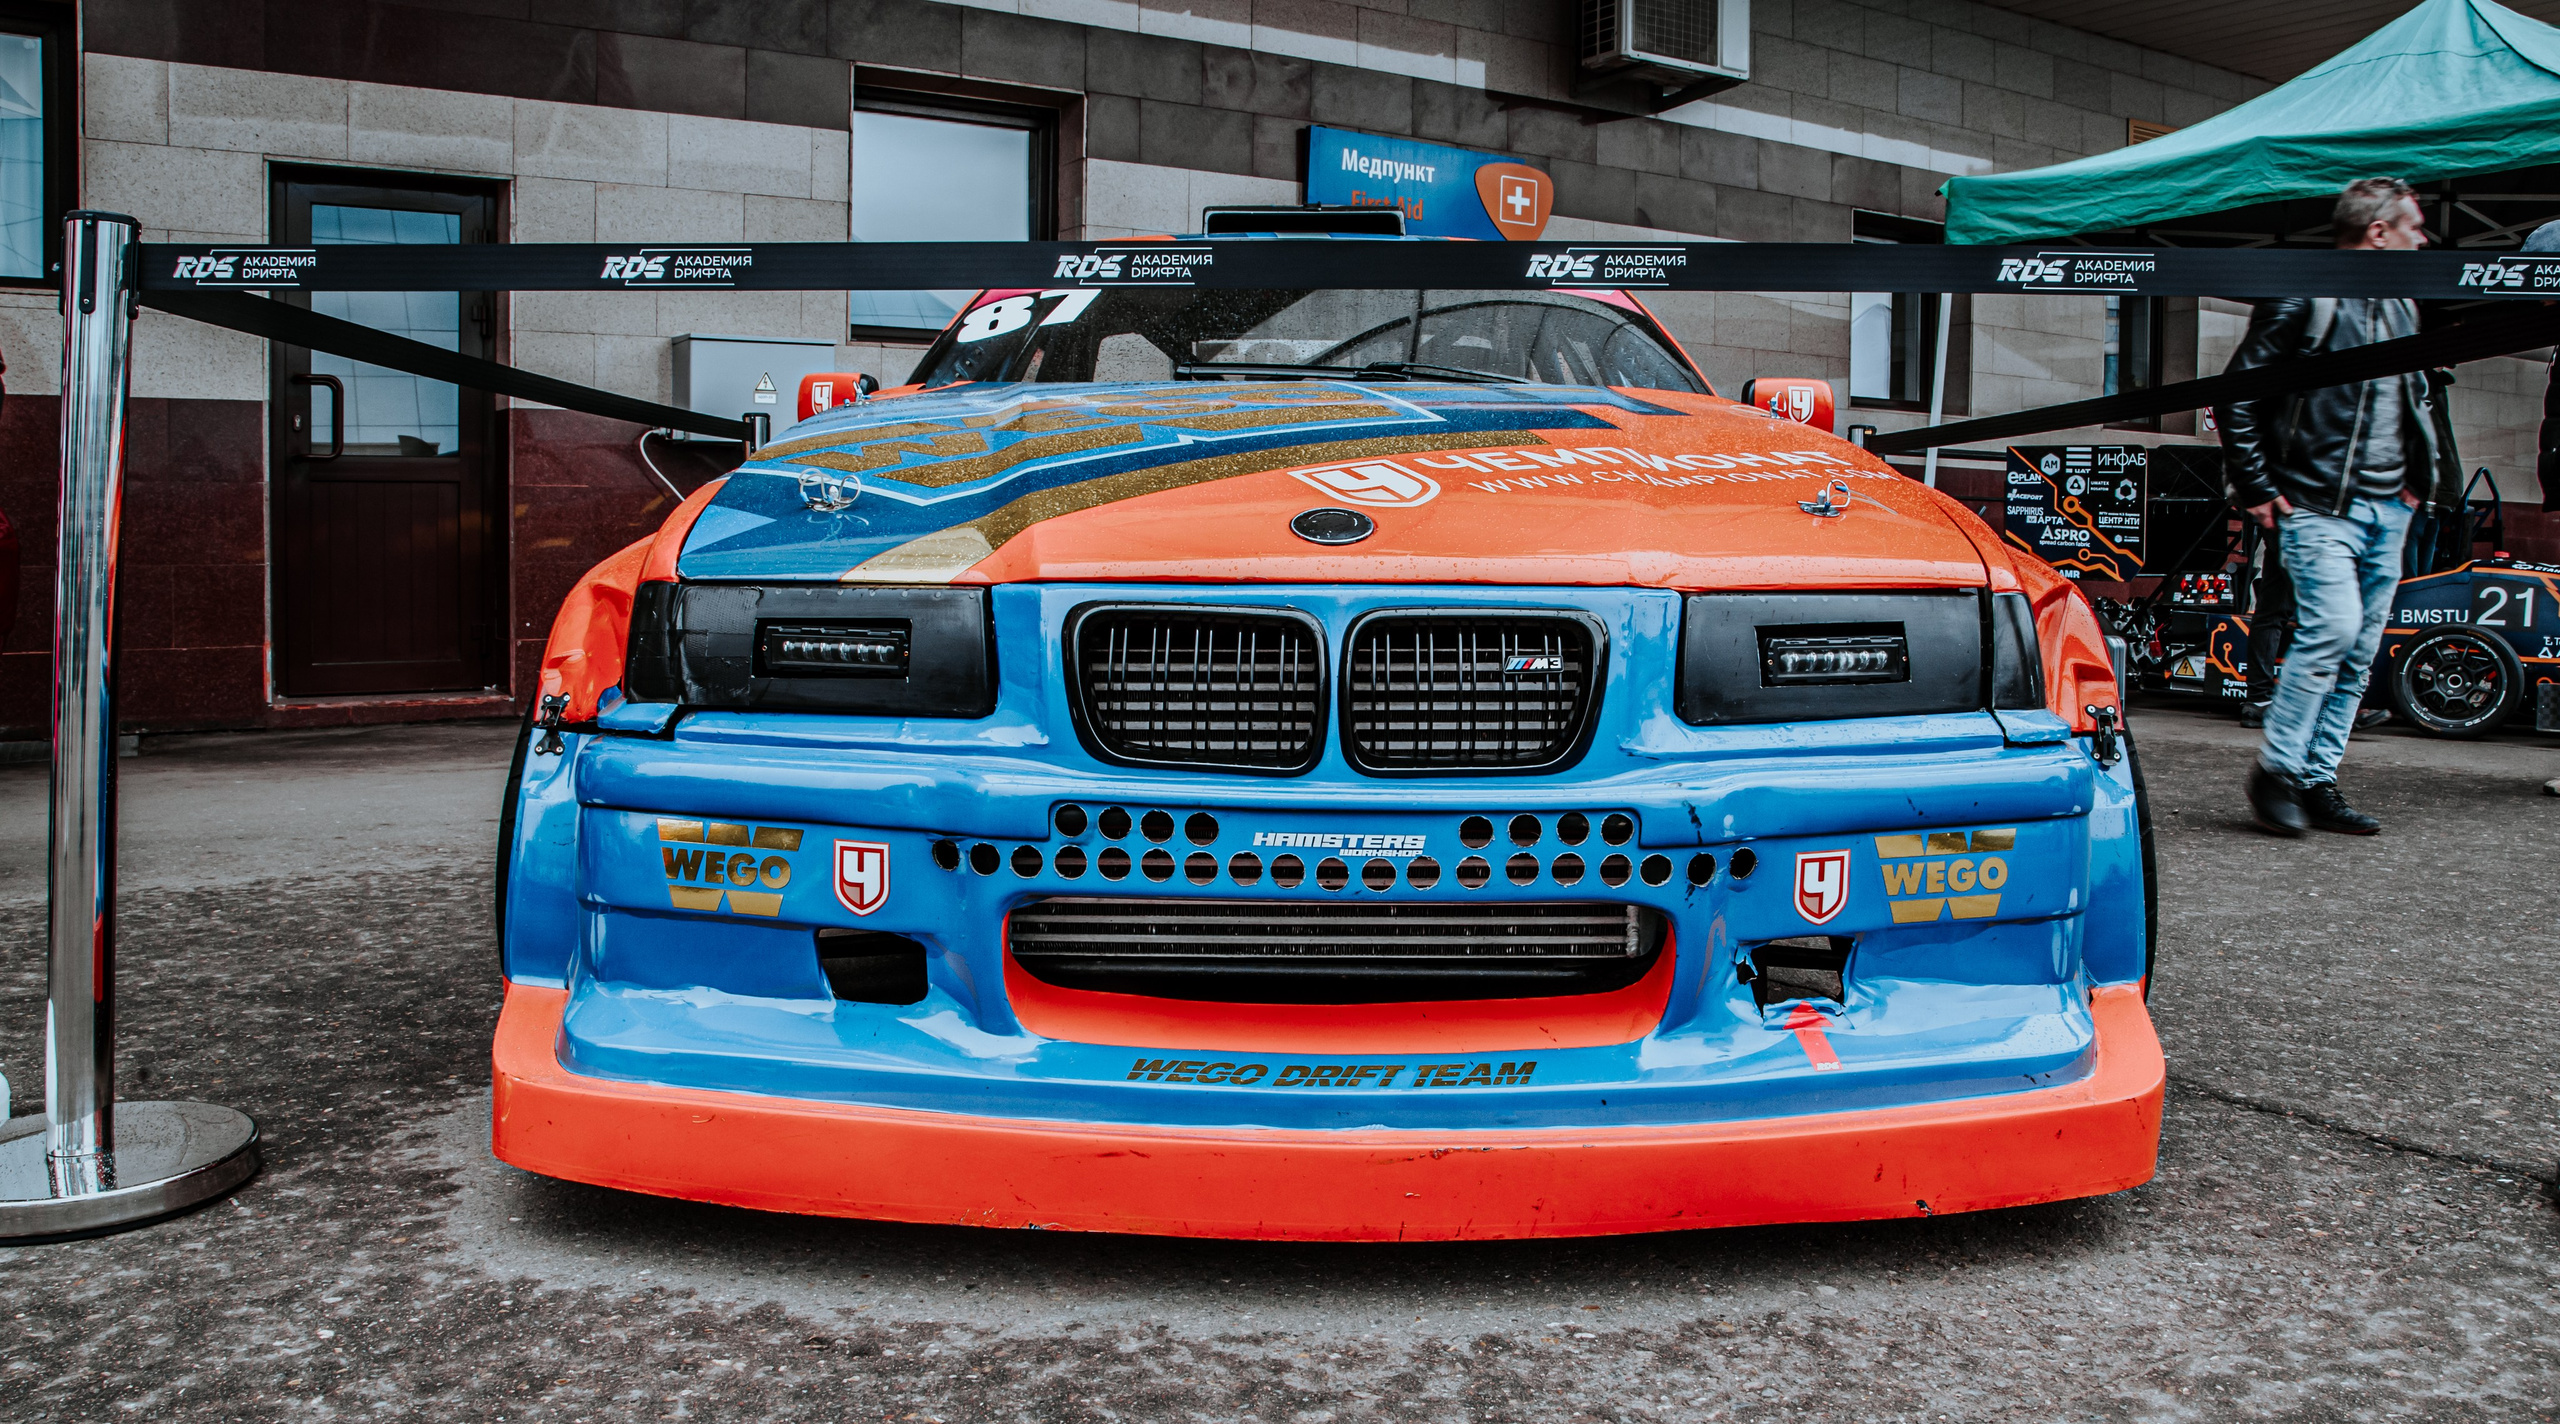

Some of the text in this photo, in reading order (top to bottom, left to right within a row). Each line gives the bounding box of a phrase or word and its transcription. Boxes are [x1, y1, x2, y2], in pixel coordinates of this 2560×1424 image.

[1341, 148, 1436, 184] Медпункт
[172, 255, 239, 279] RDS
[600, 255, 671, 279] RDS
[1053, 254, 1128, 279] RDS
[1525, 254, 1600, 278] RDS
[1996, 258, 2071, 283] RDS
[2458, 263, 2531, 287] RDS
[957, 289, 1102, 343] 87
[1413, 446, 1853, 473] ЧЕМПИОНАТ
[2043, 460, 2058, 470] AM
[2097, 453, 2147, 467] ИНФАБ
[2007, 505, 2044, 516] SAPPHIRUS
[2098, 516, 2140, 526] ЦЕНТР НТИ
[2401, 609, 2469, 623] BMSTU
[2476, 586, 2535, 628] 21
[1529, 657, 1562, 670] M3
[1253, 832, 1426, 849] HAMSTERS
[1339, 848, 1423, 857] WORKSHOP
[661, 846, 791, 889] WEGO
[1880, 856, 2008, 896] WEGO
[1126, 1058, 1538, 1088] WEGO DRIFT TEAM
